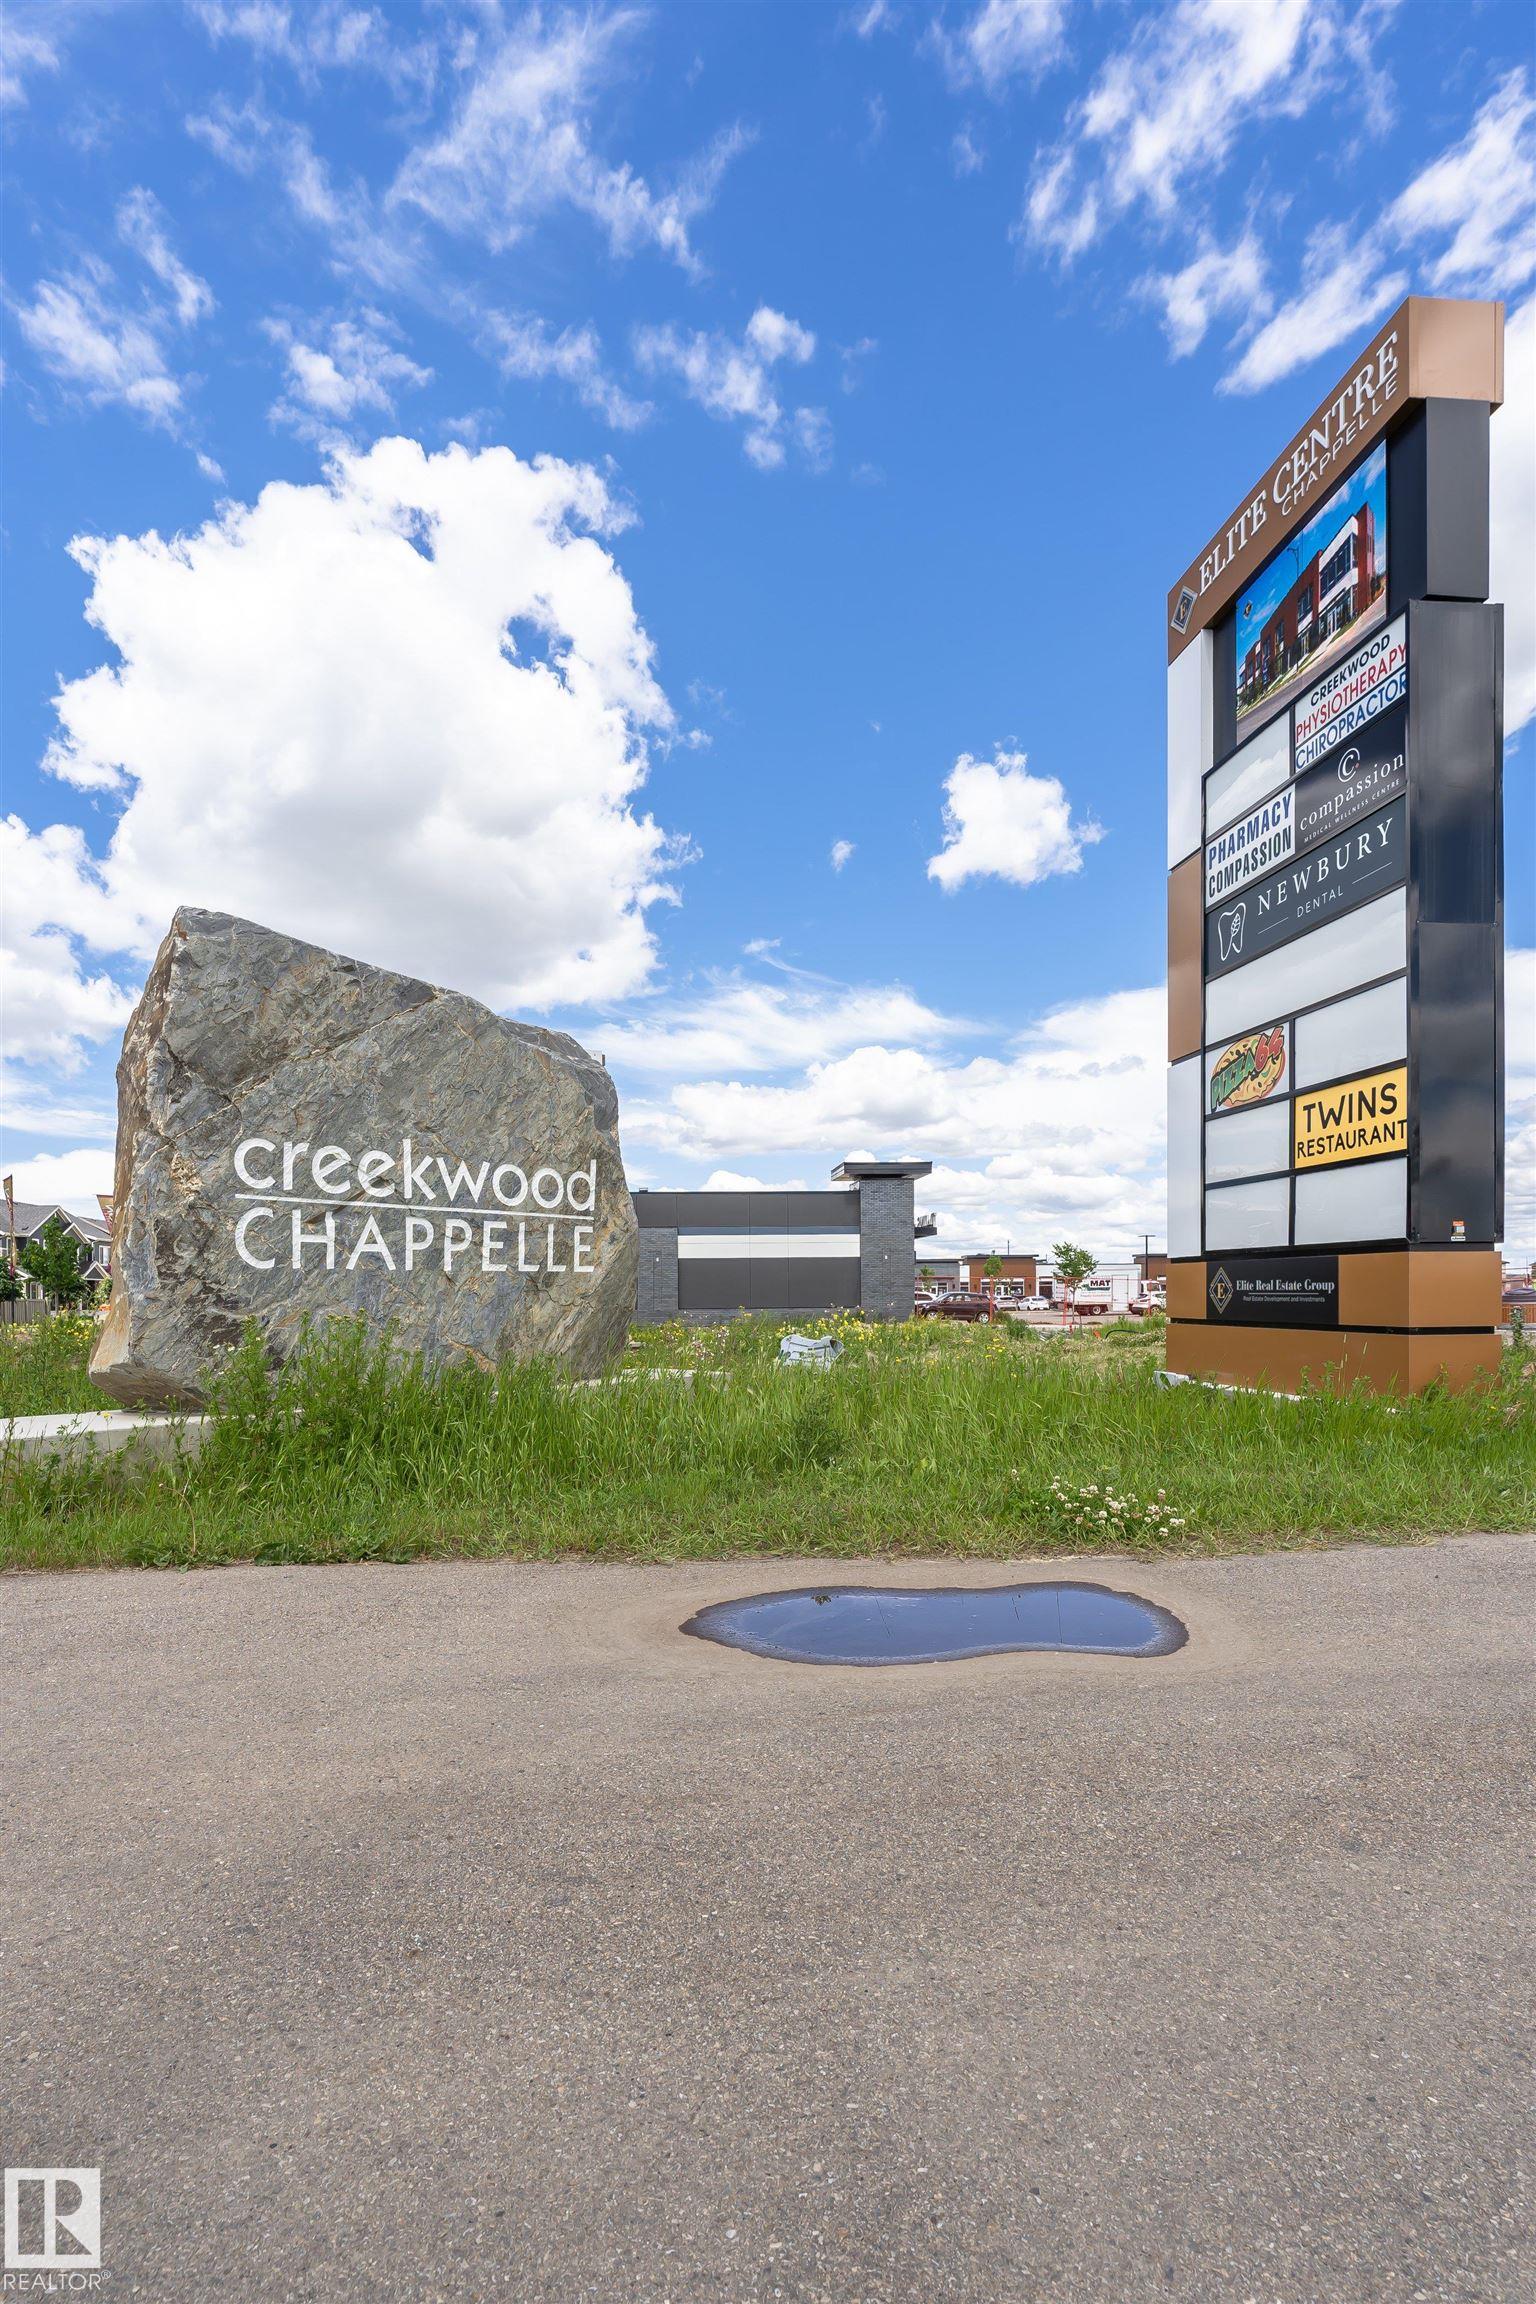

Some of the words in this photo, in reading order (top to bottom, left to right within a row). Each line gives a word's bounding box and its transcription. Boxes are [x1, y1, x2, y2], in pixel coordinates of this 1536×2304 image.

[1199, 489, 1267, 597] ELITE
[1273, 330, 1399, 505] CENTRE
[1281, 373, 1398, 516] CHAPPELLE
[1296, 642, 1406, 743] PHYSIOTHERAPY
[1310, 634, 1390, 707] CREEKWOOD
[1296, 672, 1406, 770] CHIROPRACTOR
[1300, 754, 1404, 831] compassion
[1304, 822, 1332, 843] MEDICAL
[1335, 799, 1369, 824] WELLNESS
[1372, 778, 1400, 800] CENTRE
[1208, 792, 1292, 870] PHARMACY
[1208, 825, 1292, 898] COMPASSION
[1257, 818, 1393, 916] NEWBURY
[1297, 885, 1344, 918] DENTAL
[1211, 1047, 1256, 1113] PIZZA
[1255, 1026, 1284, 1073] 64
[1297, 1119, 1407, 1159] RESTAURANT
[1303, 1082, 1398, 1133] TWINS
[234, 1206, 595, 1273] CHAPPELLE
[1236, 1280, 1254, 1291] Elite
[1256, 1280, 1273, 1291] Real
[1276, 1280, 1302, 1291] Estate
[1304, 1278, 1335, 1294] Group
